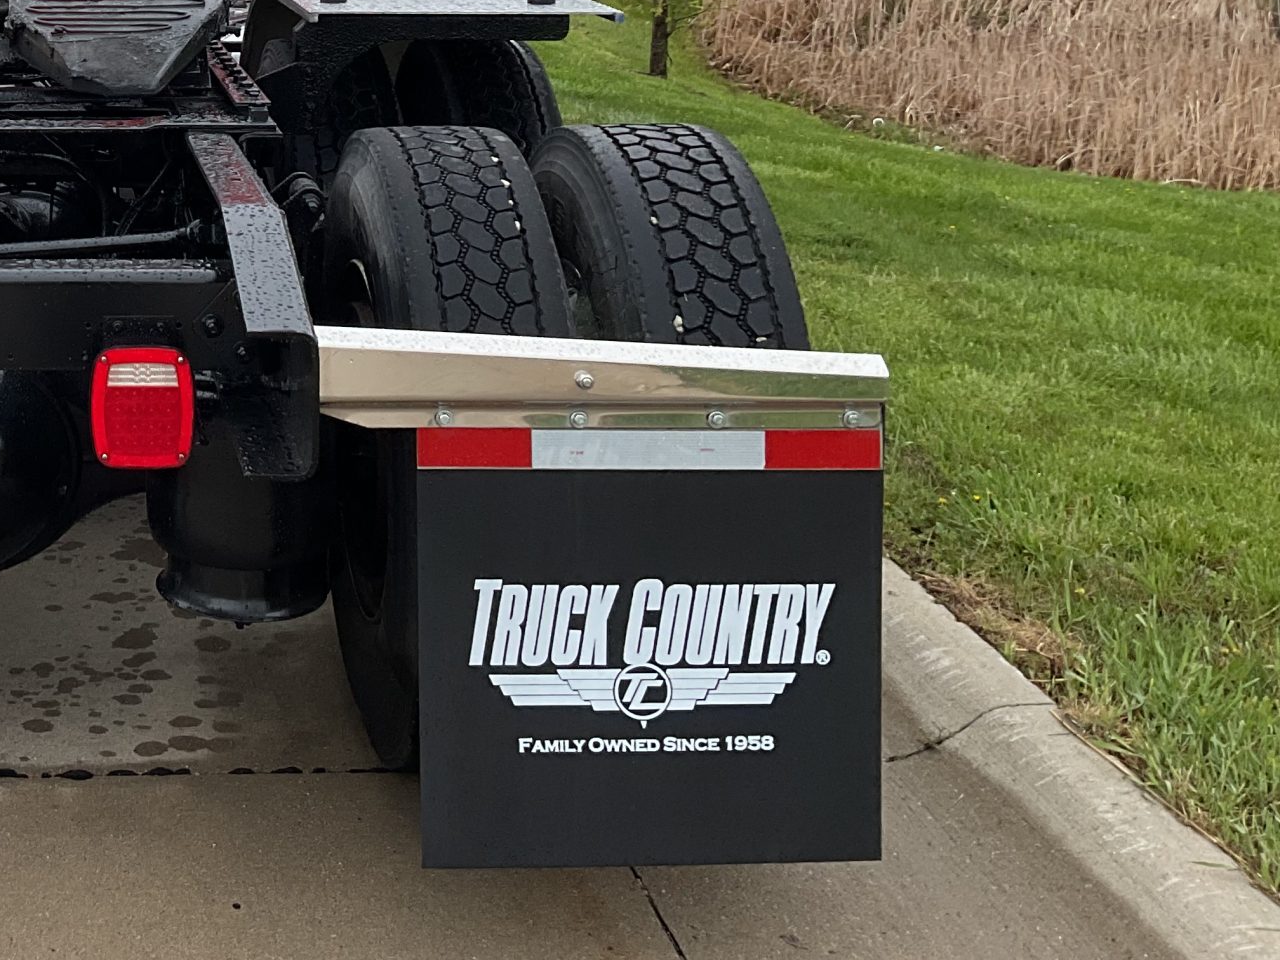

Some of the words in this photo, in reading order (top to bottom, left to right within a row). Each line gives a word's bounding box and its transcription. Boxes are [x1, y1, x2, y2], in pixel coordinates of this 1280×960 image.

[468, 578, 620, 666] TRUCK
[622, 578, 836, 666] COUNTRY
[517, 737, 586, 753] FAMILY
[588, 736, 660, 752] OWNED
[663, 736, 721, 752] SINCE
[724, 735, 775, 751] 1958
